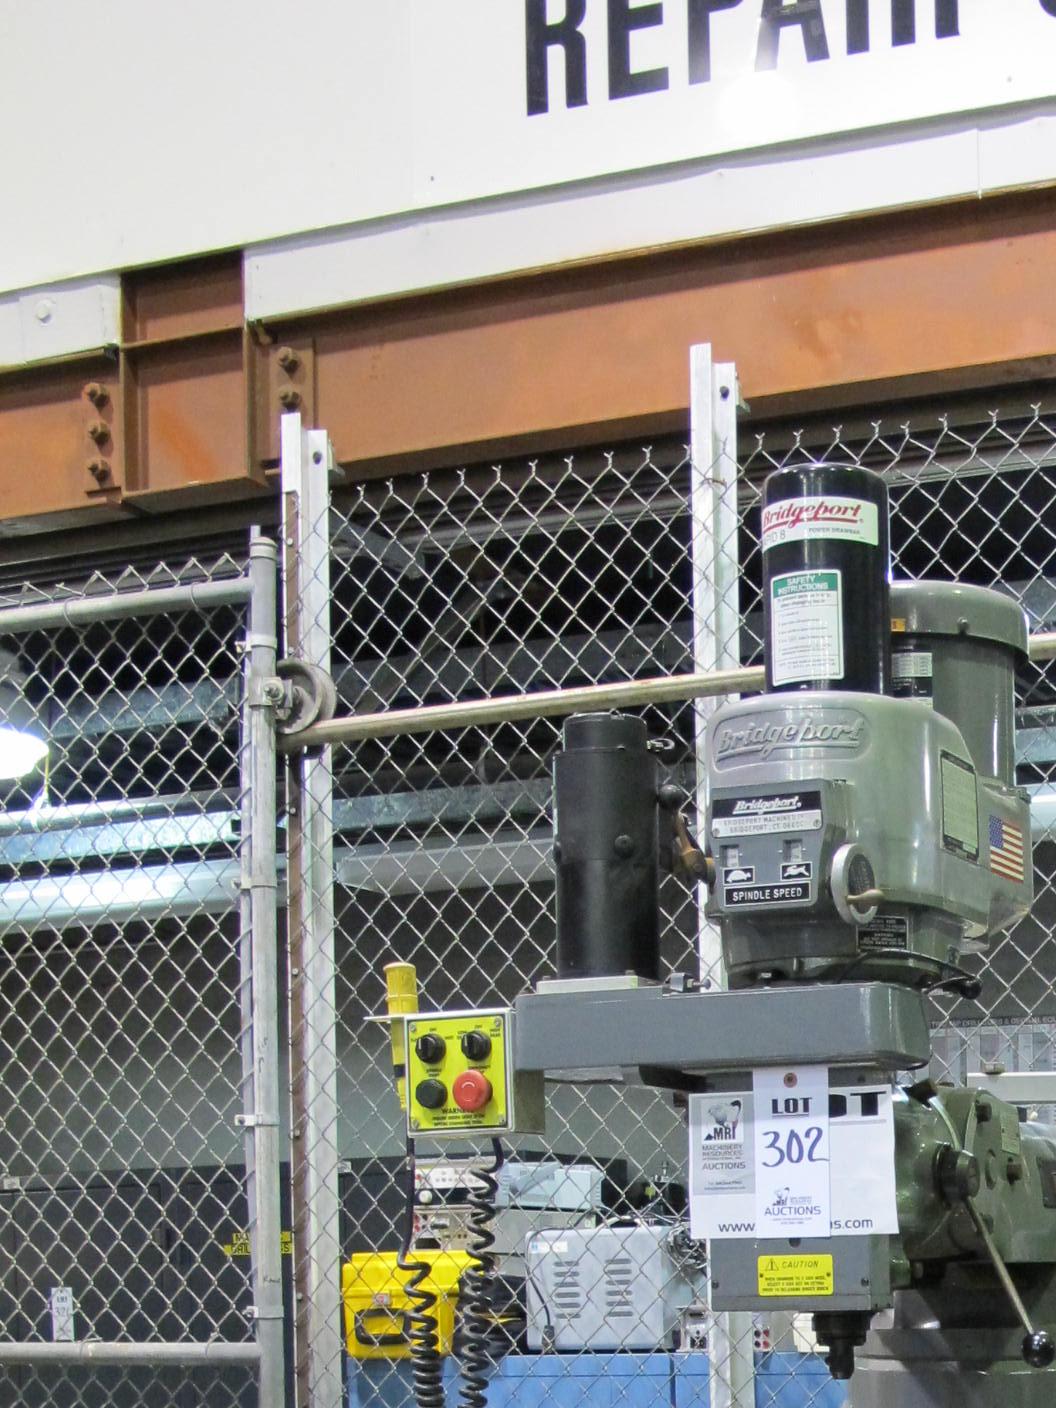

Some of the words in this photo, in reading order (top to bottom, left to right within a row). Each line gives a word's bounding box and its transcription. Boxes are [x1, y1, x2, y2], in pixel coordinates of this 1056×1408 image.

[763, 501, 861, 531] Bridgeport
[716, 718, 864, 762] Bridgeport
[732, 796, 799, 815] Bridgeport
[732, 889, 771, 902] SPINDLE
[773, 887, 803, 899] SPEED
[771, 1097, 813, 1115] LOT
[713, 1126, 737, 1141] MRI
[761, 1126, 829, 1168] 302
[702, 1161, 746, 1170] AUCTIONS
[764, 1206, 822, 1216] AUCTIONS
[781, 1260, 819, 1270] CAUTION
